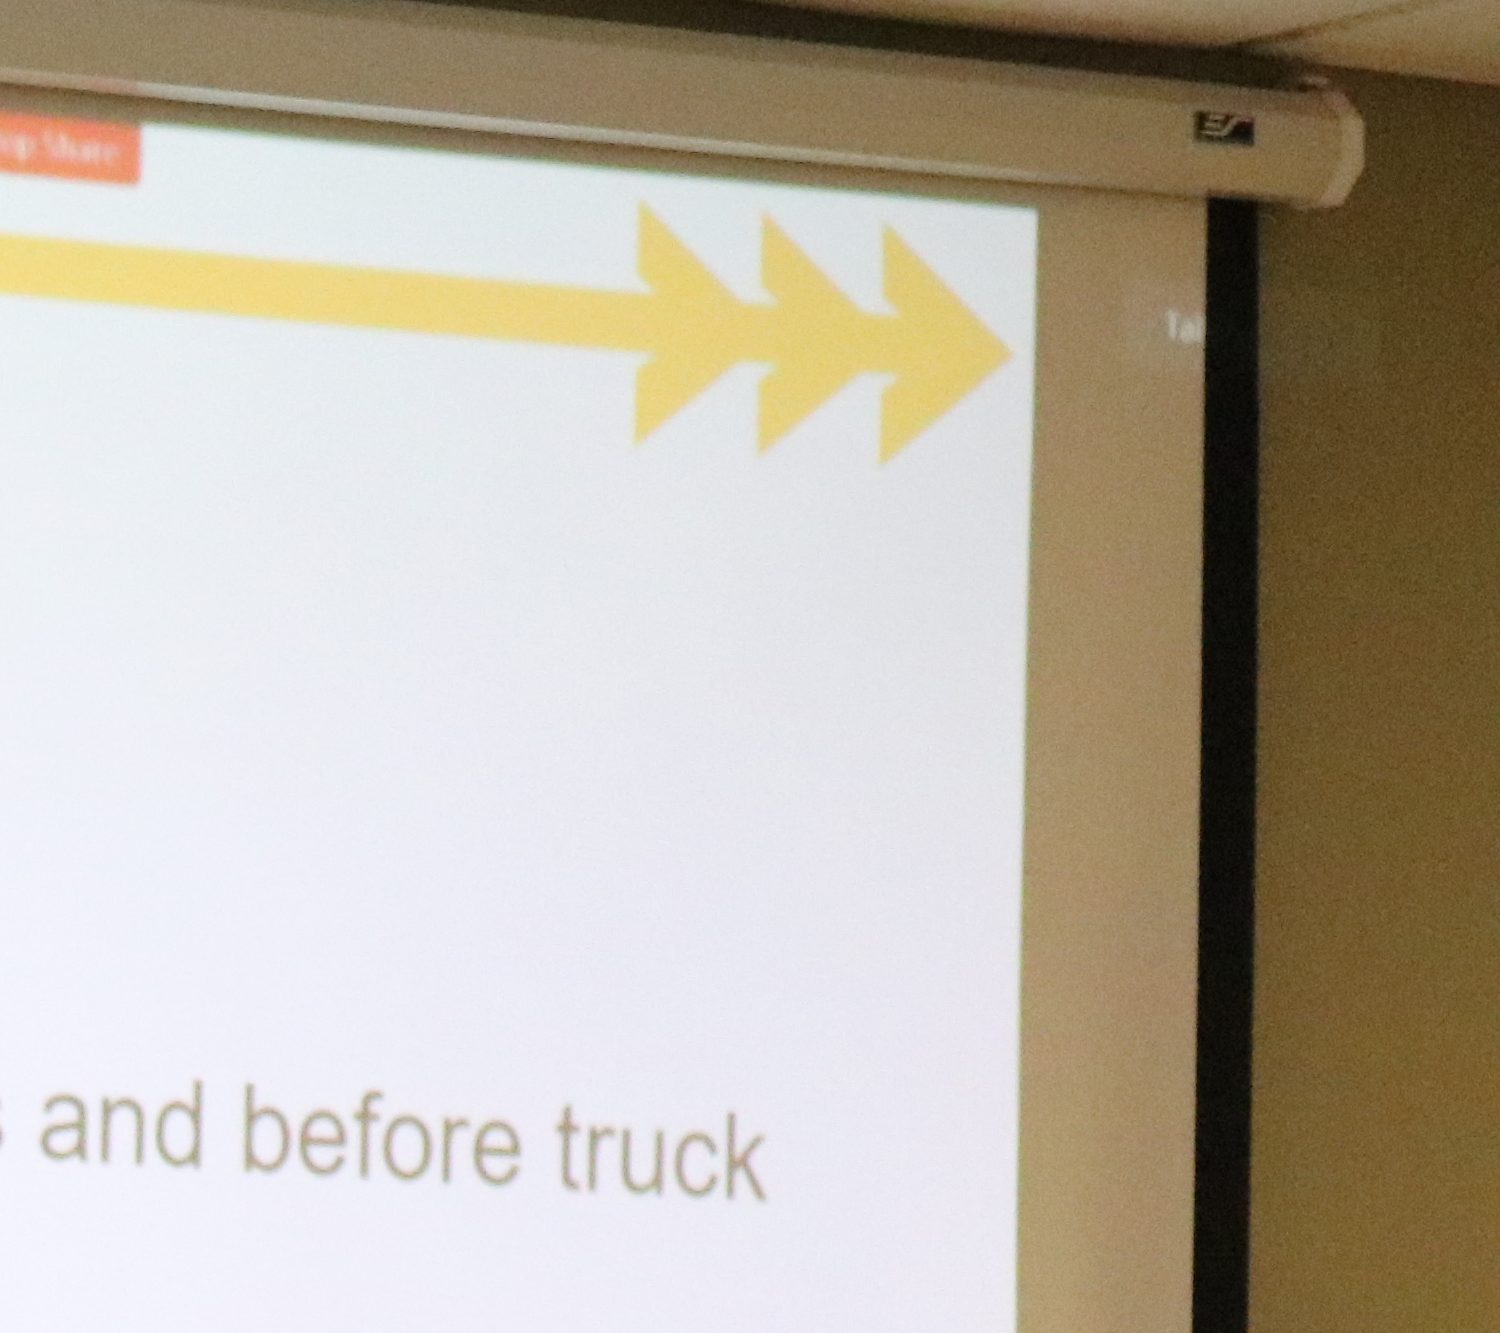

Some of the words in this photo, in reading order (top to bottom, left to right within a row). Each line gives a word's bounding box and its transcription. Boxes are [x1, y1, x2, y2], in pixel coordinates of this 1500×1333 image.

[37, 1078, 206, 1171] and
[240, 1081, 525, 1190] before
[553, 1103, 768, 1203] truck
